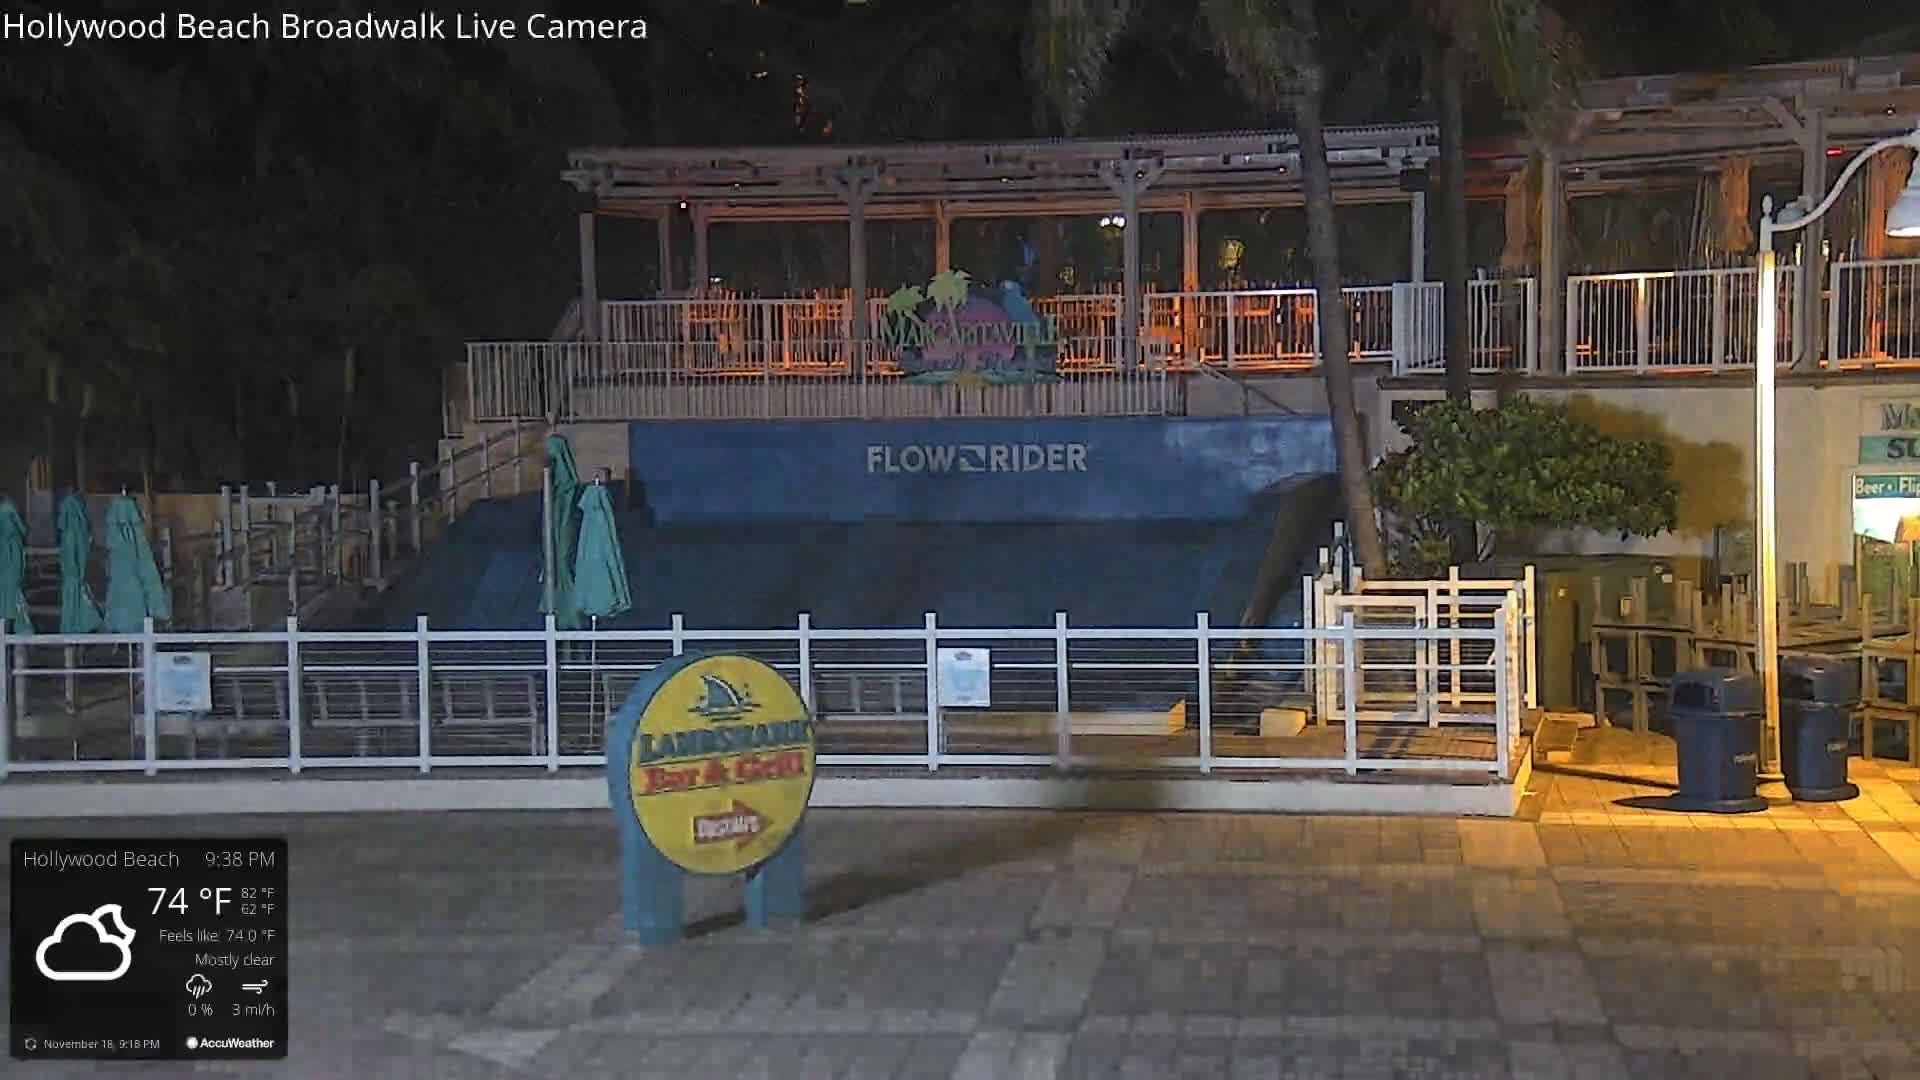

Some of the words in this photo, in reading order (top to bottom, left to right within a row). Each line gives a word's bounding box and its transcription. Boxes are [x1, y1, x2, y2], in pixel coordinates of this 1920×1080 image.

[867, 444, 955, 473] FLOW
[989, 443, 1089, 472] RIDER
[1856, 477, 1886, 495] Beer
[639, 766, 699, 795] Bar
